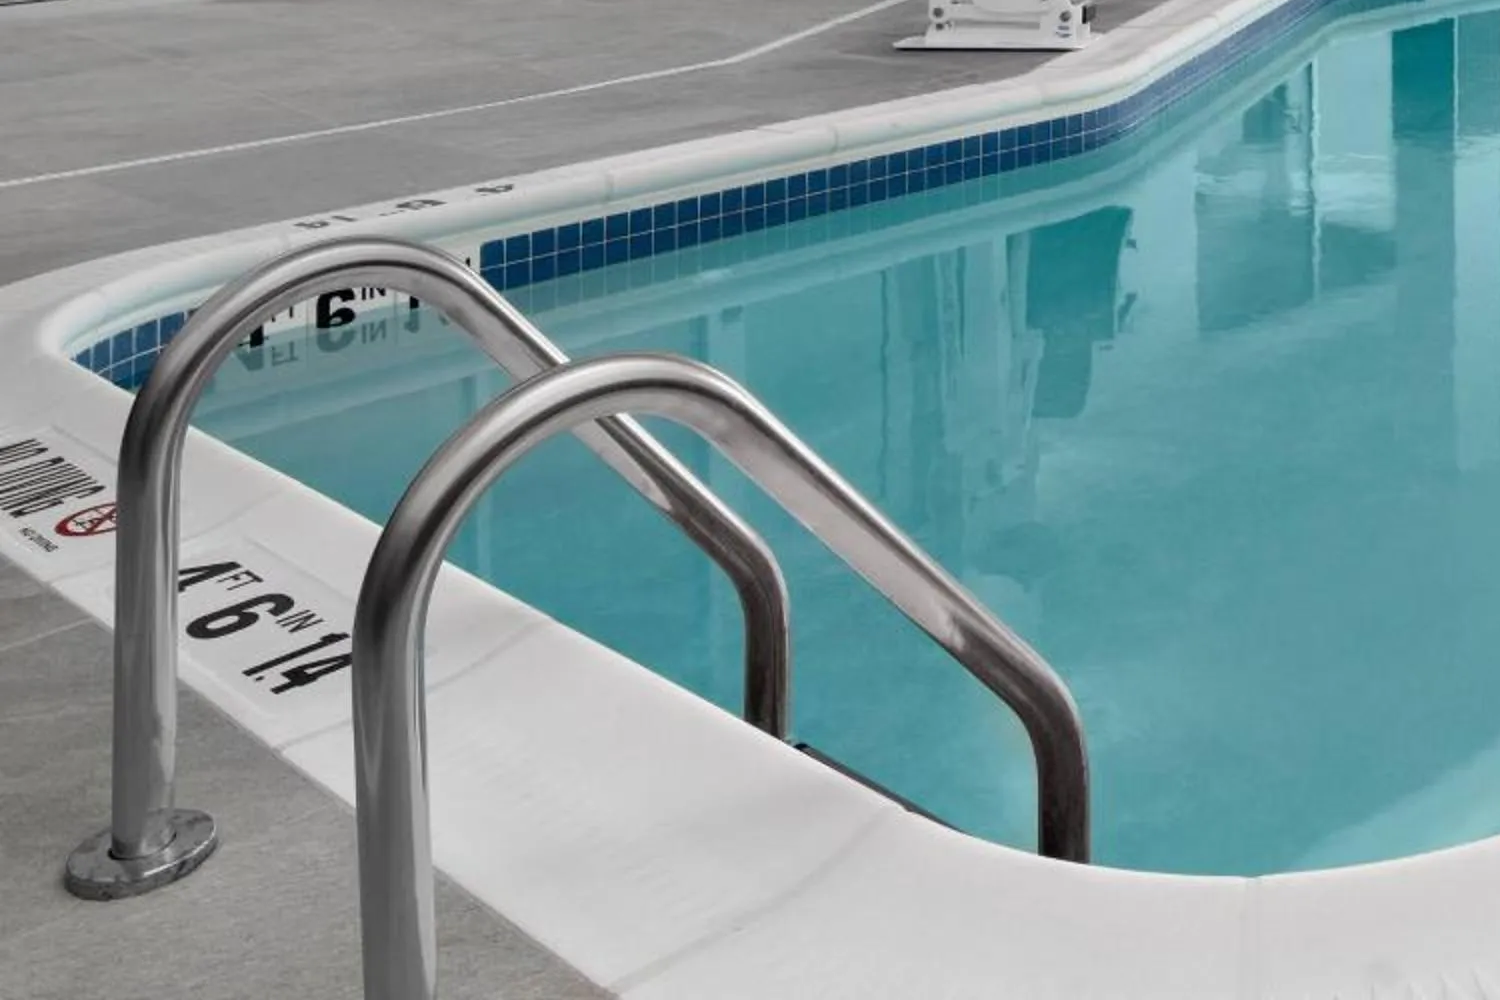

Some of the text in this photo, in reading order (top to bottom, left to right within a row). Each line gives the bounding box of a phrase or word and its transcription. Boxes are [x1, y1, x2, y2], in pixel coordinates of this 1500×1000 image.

[316, 287, 356, 329] 6
[216, 569, 264, 591] FT
[186, 593, 295, 640] 6
[276, 609, 325, 633] IN
[242, 632, 352, 694] 1.4
